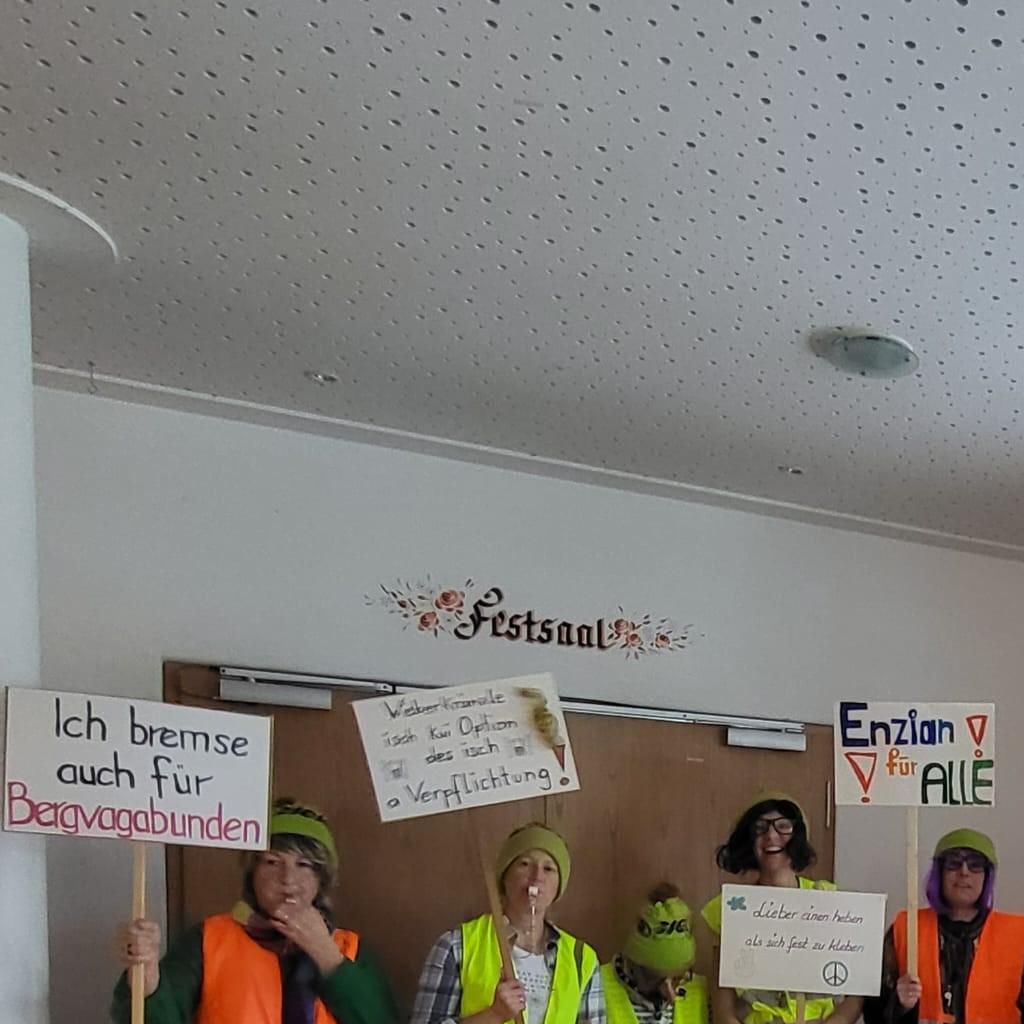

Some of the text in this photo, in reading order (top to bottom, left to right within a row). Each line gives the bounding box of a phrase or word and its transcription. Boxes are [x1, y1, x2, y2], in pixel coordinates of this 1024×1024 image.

[454, 587, 614, 650] Festsaal
[55, 697, 249, 757] Ich bremse
[839, 701, 955, 748] Enzian
[56, 751, 213, 799] auch für
[886, 747, 919, 776] für
[921, 759, 994, 806] ALLE
[7, 781, 261, 844] Bergvagabunden
[752, 901, 864, 925] Lieber einen heben
[745, 932, 865, 954] als sich fest zu kleben
